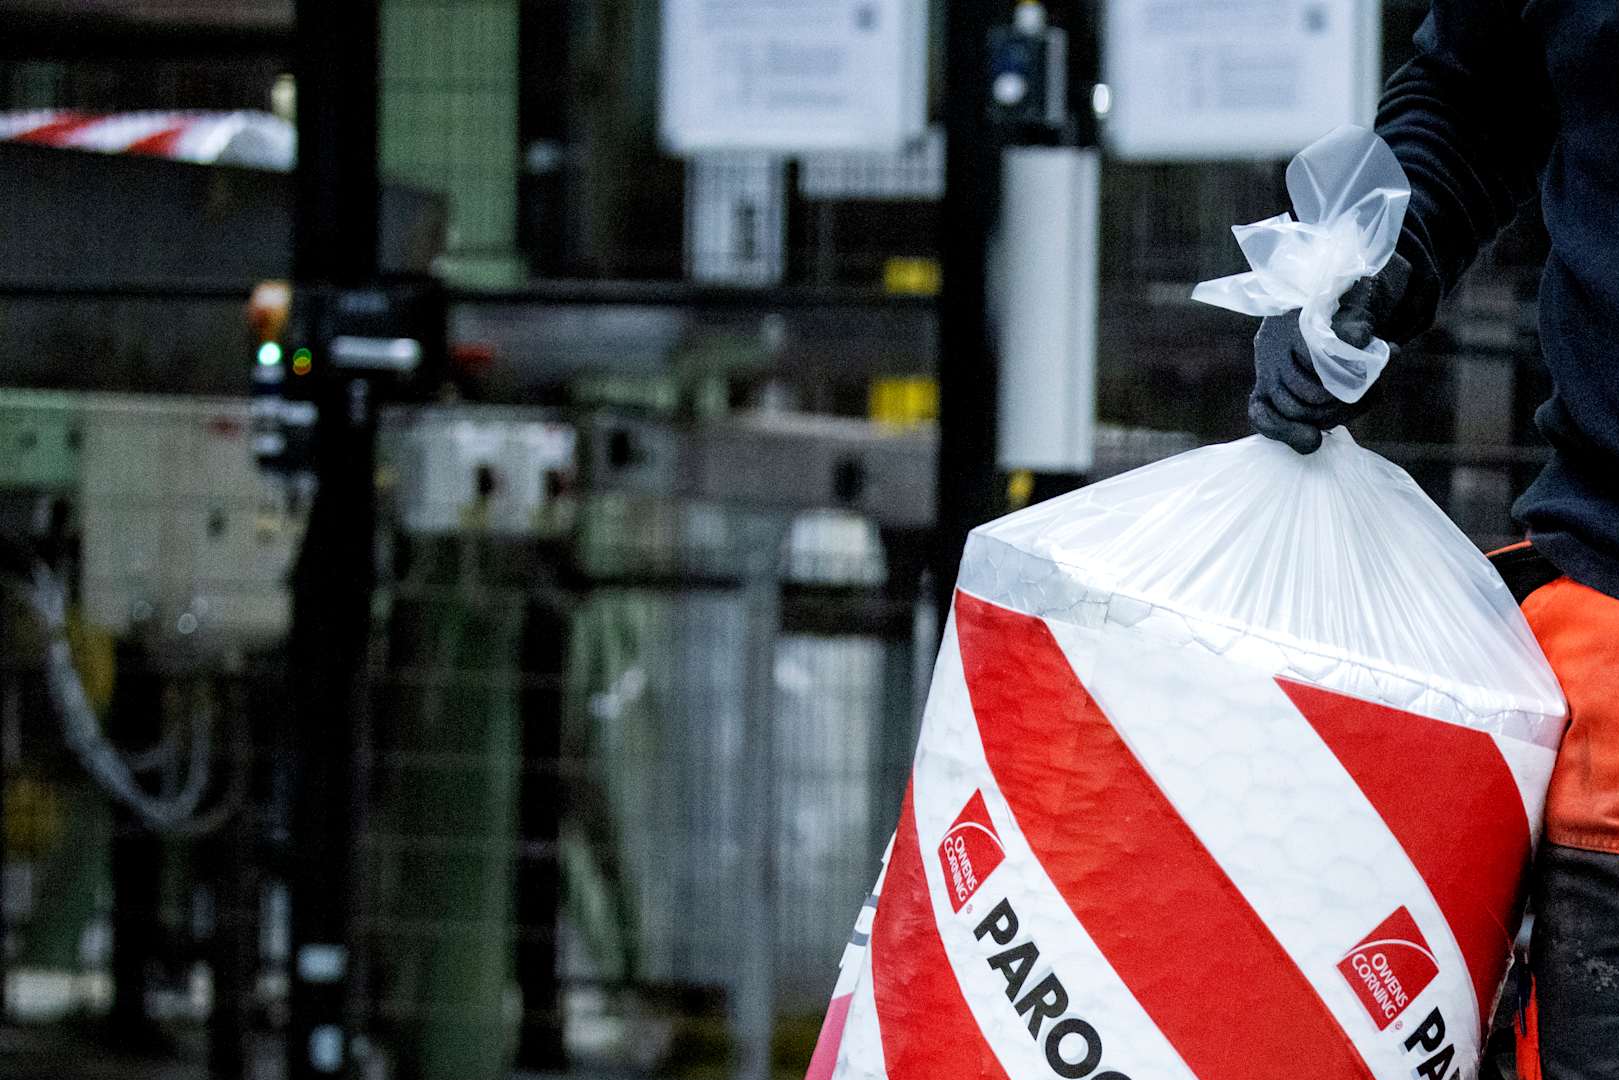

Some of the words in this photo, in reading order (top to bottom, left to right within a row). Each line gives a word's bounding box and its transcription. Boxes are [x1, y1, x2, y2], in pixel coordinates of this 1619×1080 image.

[944, 836, 968, 902] CORNING
[954, 835, 978, 891] OWENS
[1351, 953, 1398, 1019] CORNING
[1372, 952, 1408, 1008] OWENS
